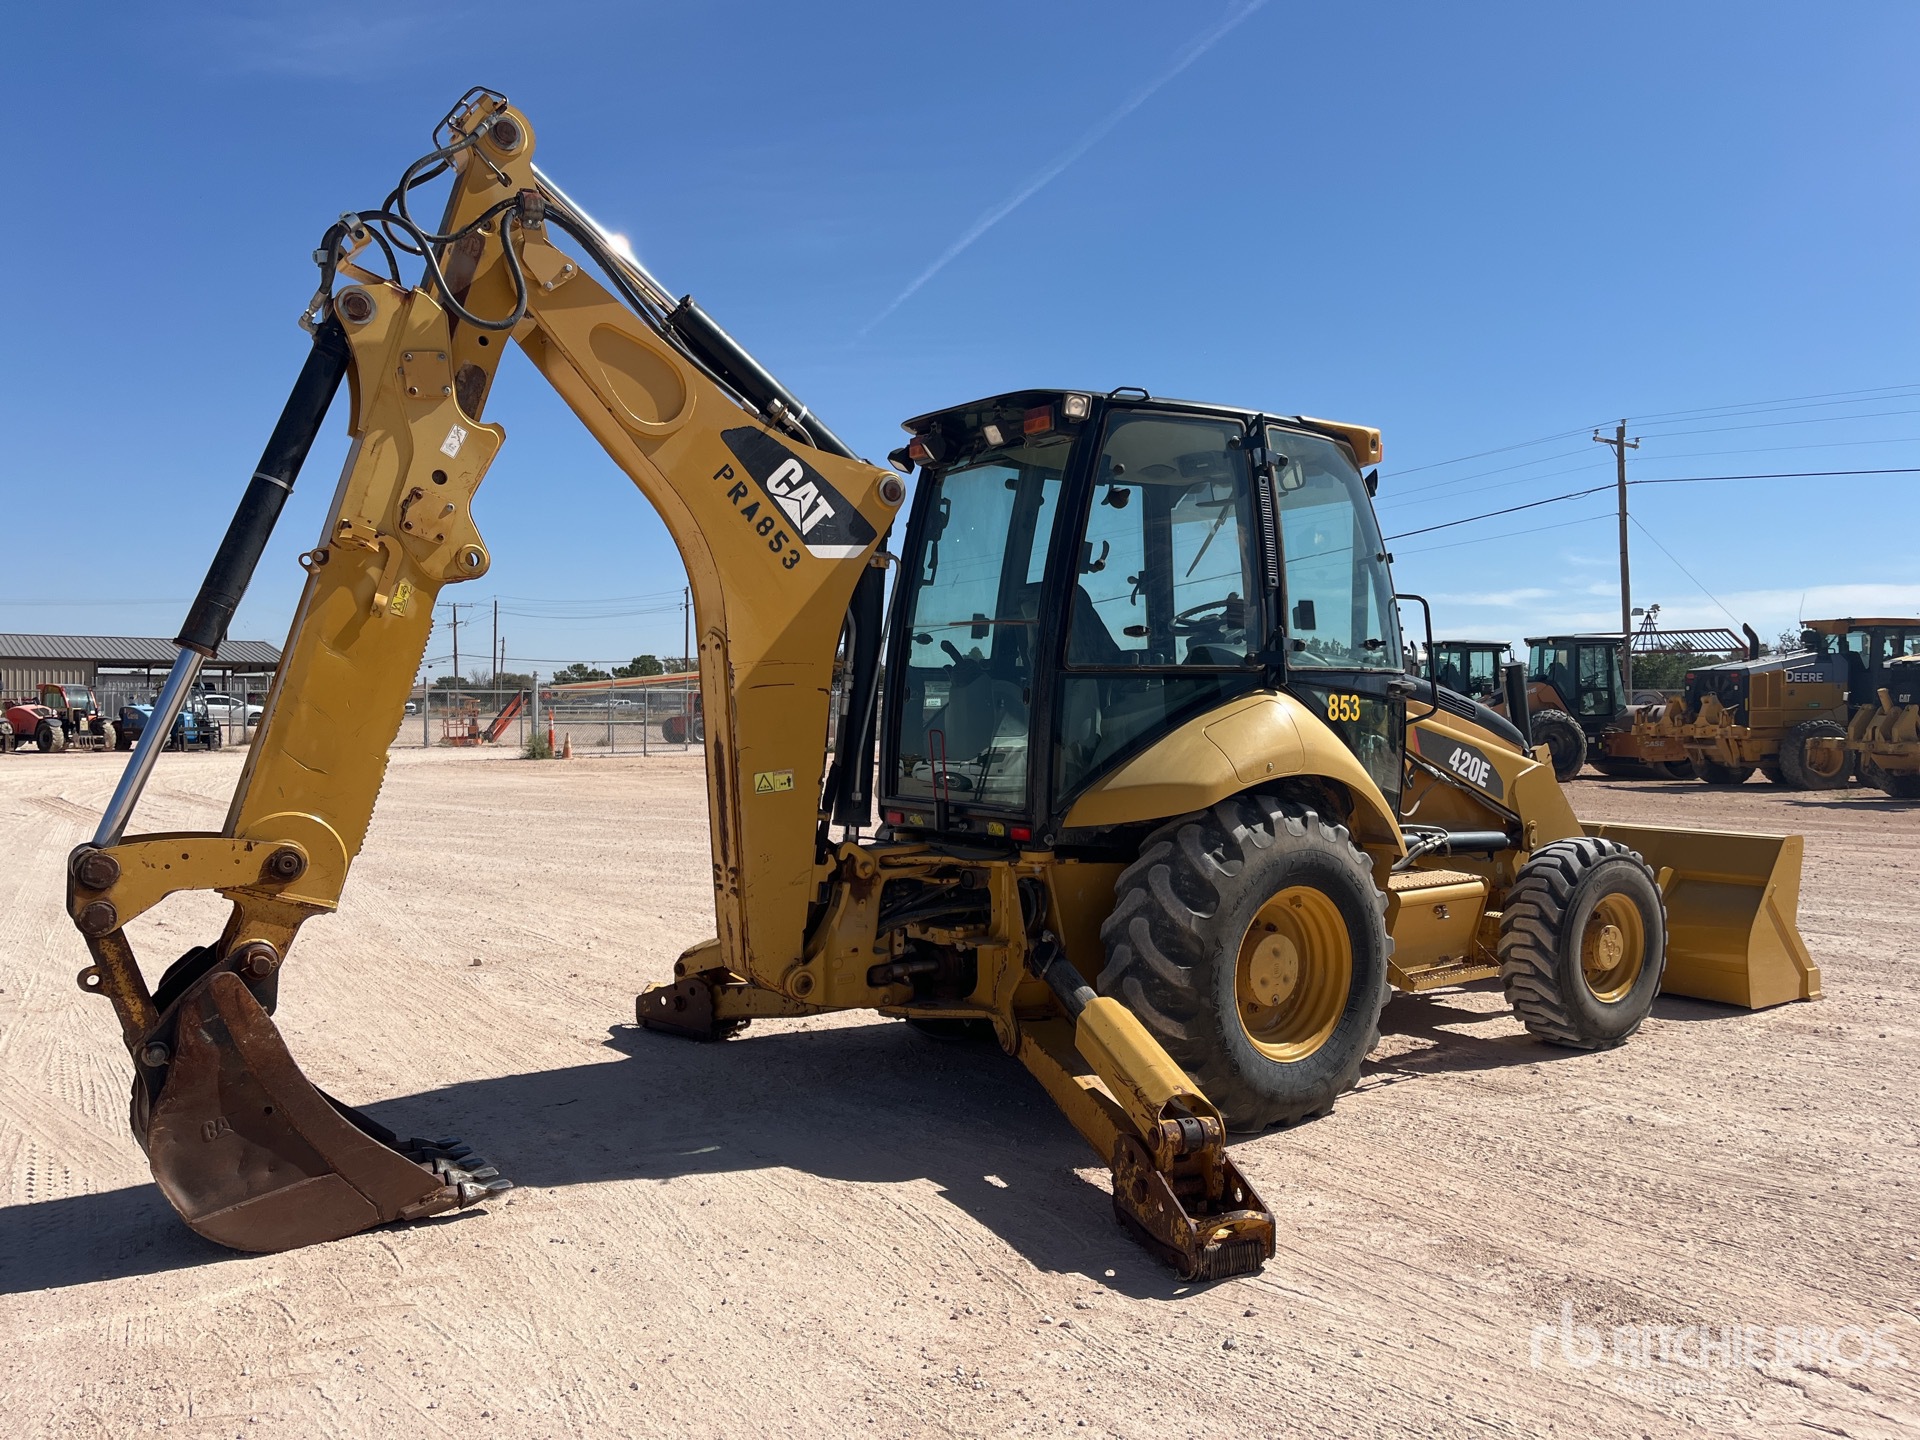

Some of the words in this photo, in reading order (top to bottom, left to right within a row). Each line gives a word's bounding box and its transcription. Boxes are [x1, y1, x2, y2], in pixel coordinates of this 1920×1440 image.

[713, 463, 800, 570] PRA853
[766, 458, 836, 536] CAT
[1785, 671, 1824, 683] DEERE
[1327, 693, 1361, 722] 853
[1448, 746, 1491, 788] 420E
